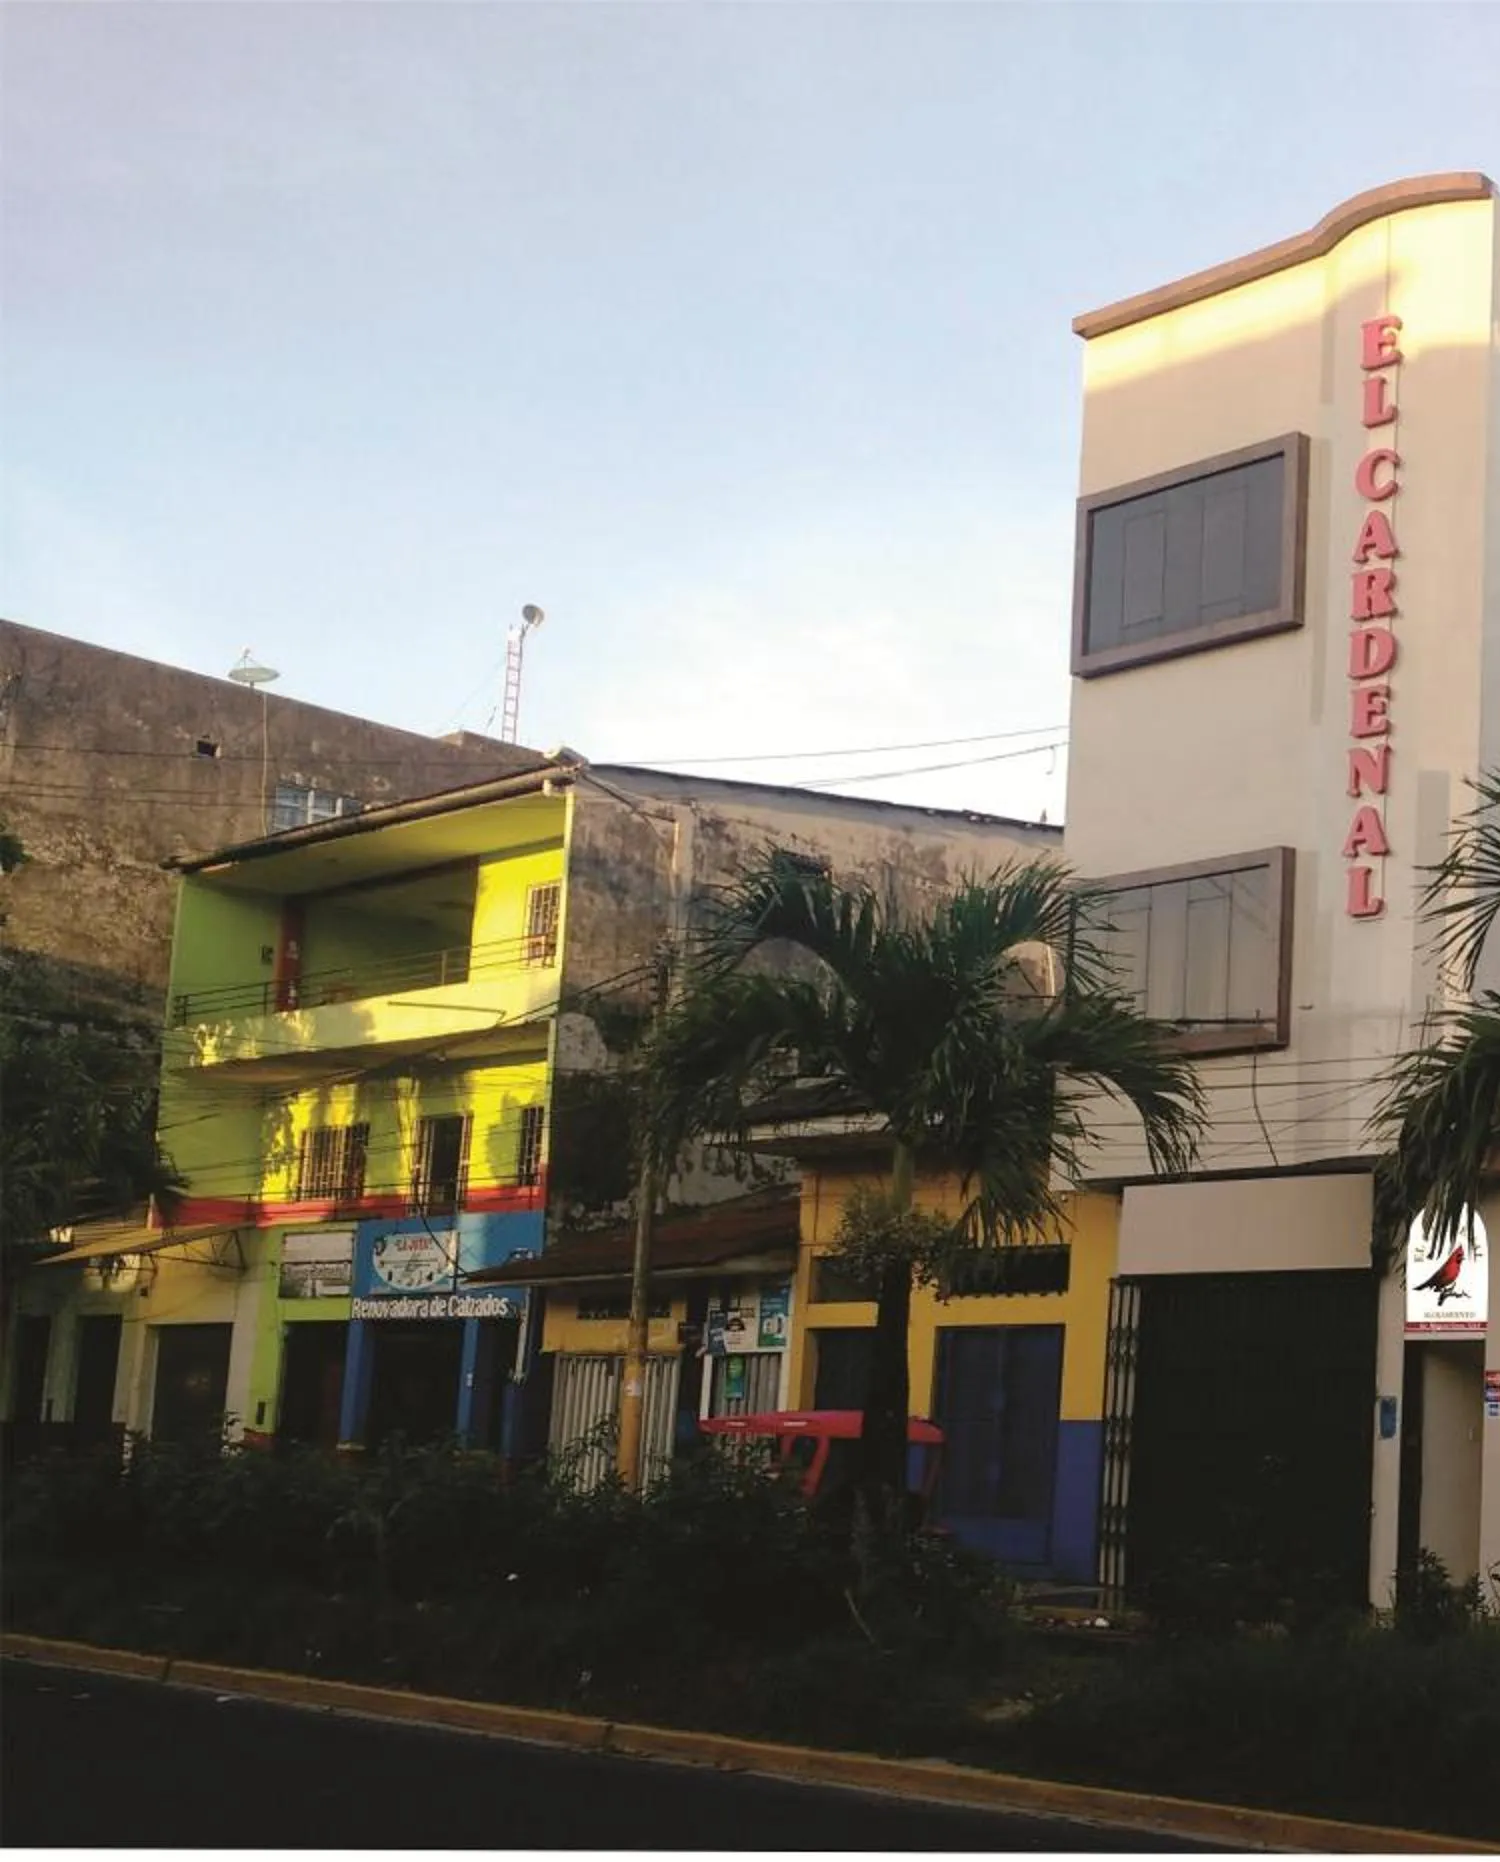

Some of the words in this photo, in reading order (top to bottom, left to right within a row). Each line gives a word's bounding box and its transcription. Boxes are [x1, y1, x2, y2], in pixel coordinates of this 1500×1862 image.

[1360, 315, 1404, 428] EL
[1343, 448, 1403, 919] CARDENAL
[352, 1297, 428, 1319] Renovadora
[430, 1296, 446, 1316] de
[450, 1294, 509, 1316] Calzados
